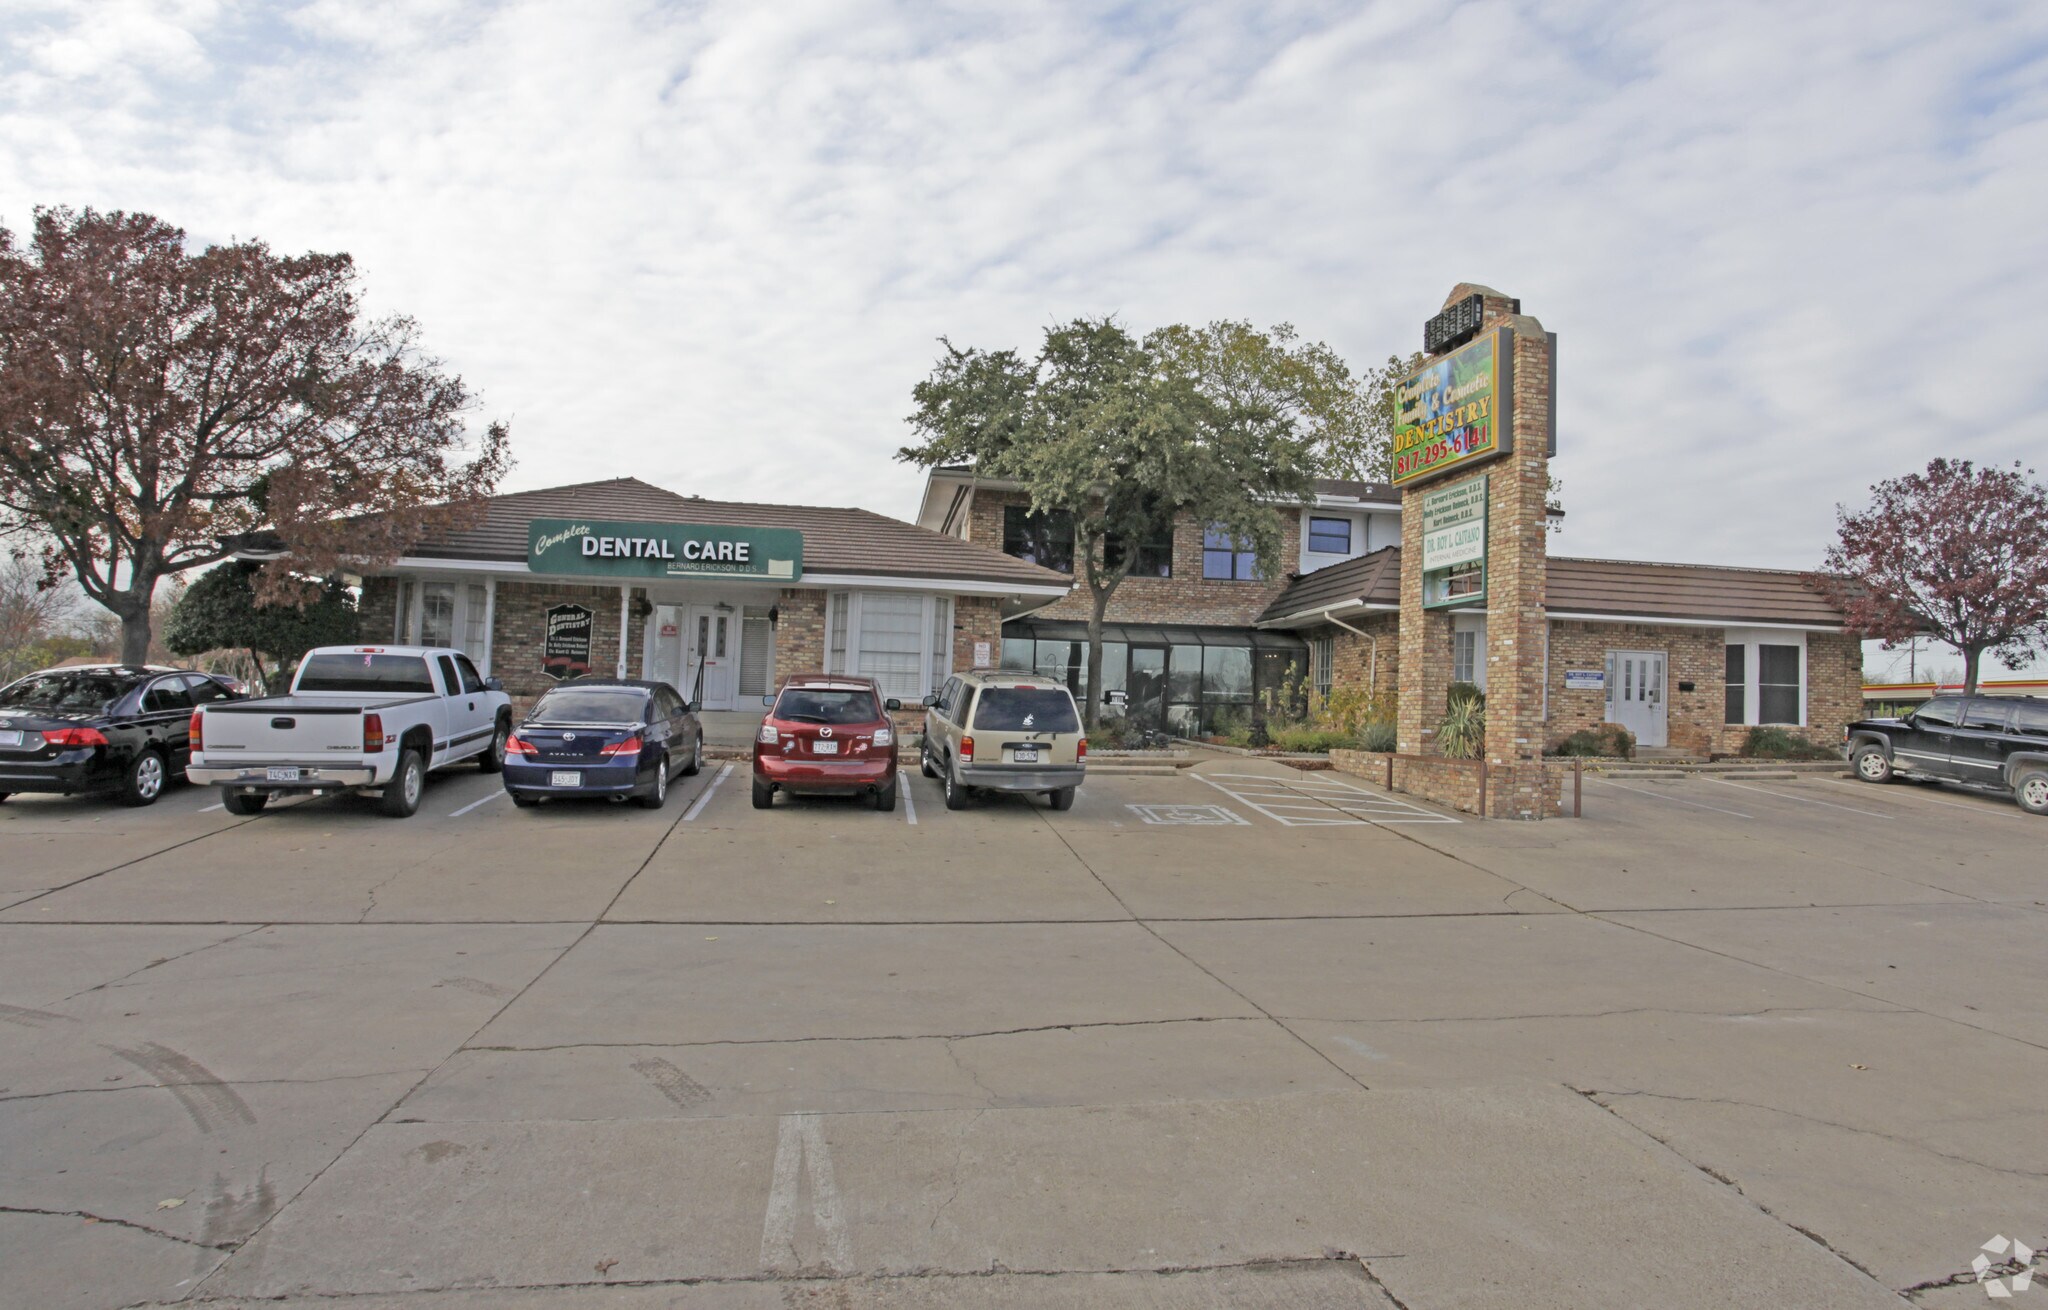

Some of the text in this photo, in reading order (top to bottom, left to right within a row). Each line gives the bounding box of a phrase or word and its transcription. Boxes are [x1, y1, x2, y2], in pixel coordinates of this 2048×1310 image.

[1431, 392, 1440, 411] &
[1395, 395, 1491, 454] DENTISTRY
[1397, 421, 1488, 475] 817-295-6141
[535, 524, 591, 556] Complete
[582, 536, 750, 561] DENTAL CARE
[667, 562, 700, 570] BERNARD
[1430, 546, 1477, 564] INTERNAL MEDICINE
